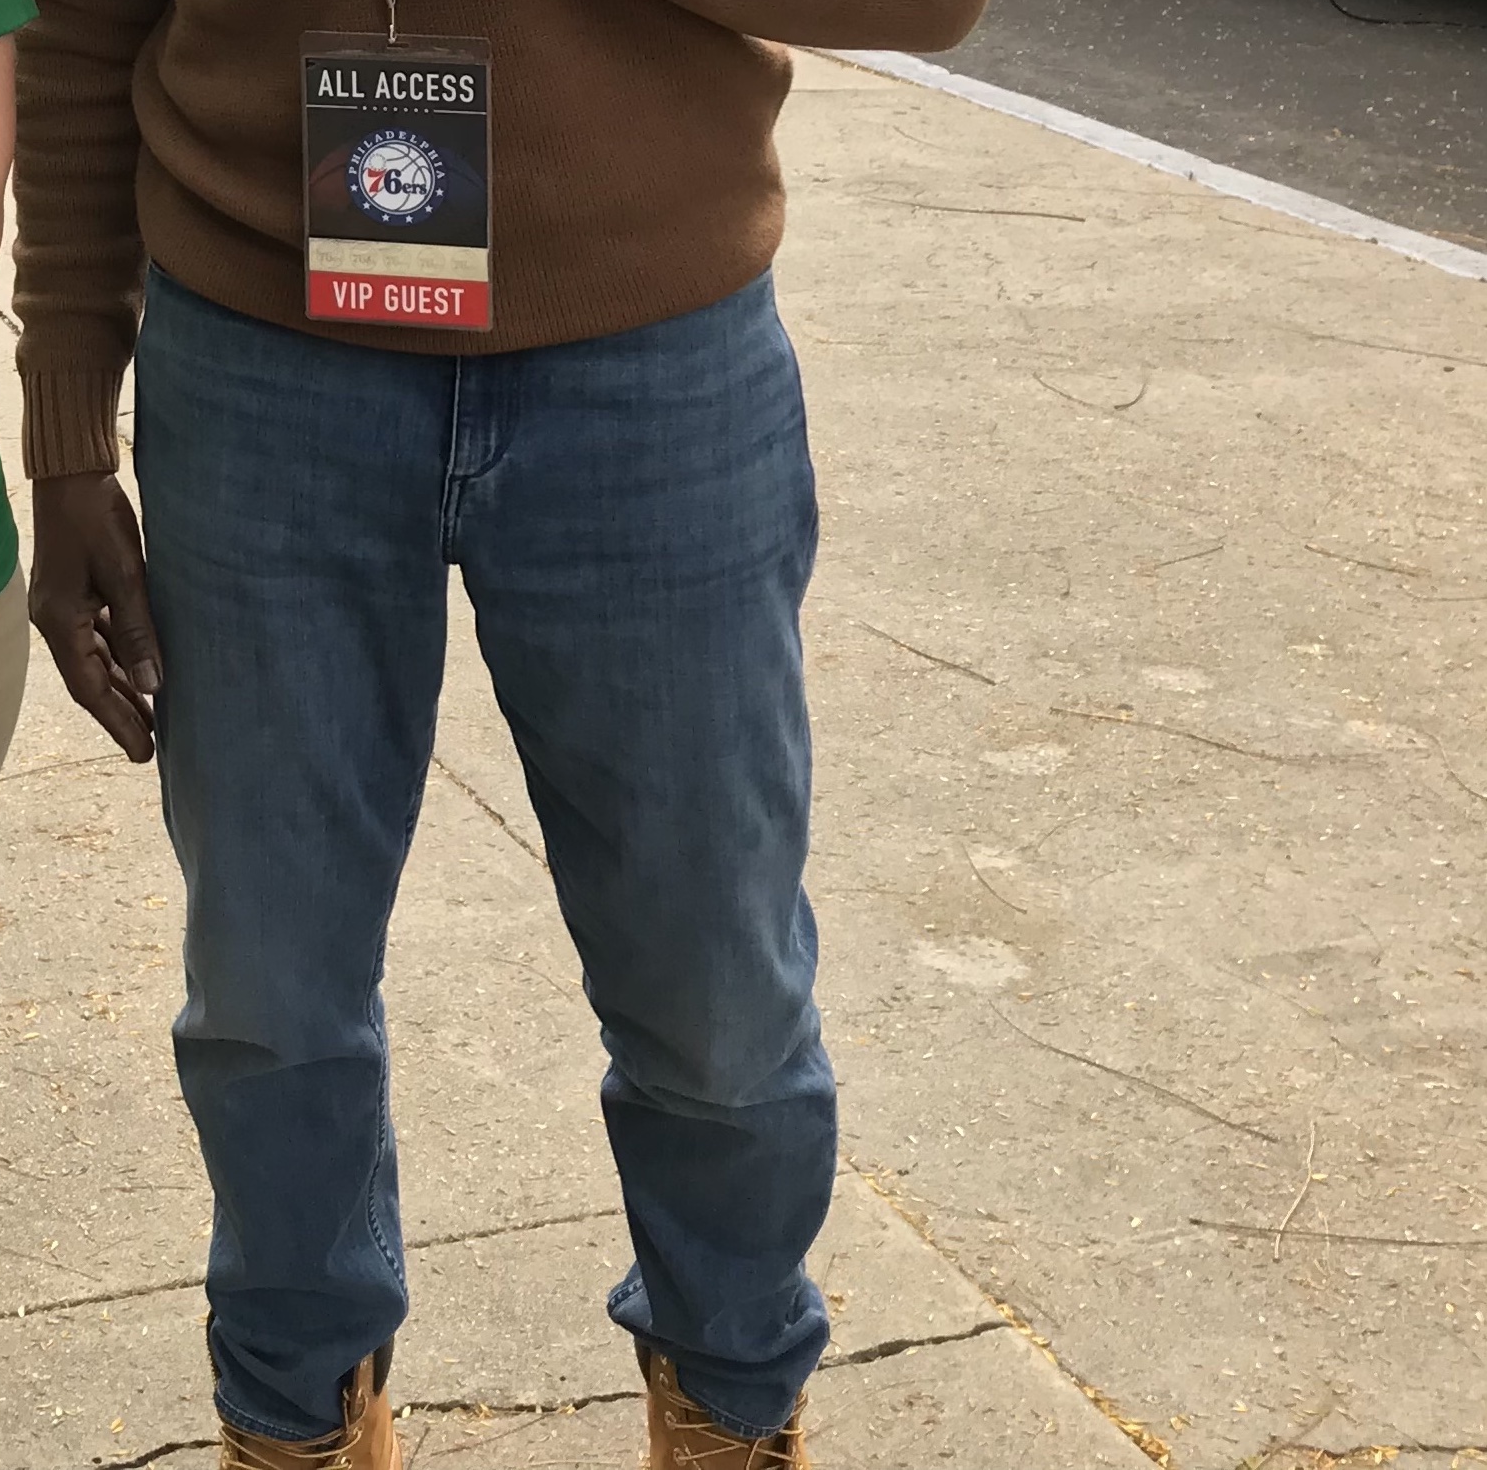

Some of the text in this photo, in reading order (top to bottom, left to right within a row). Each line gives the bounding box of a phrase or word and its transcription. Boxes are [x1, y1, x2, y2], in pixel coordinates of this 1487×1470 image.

[318, 69, 474, 103] ALL ACCESS
[348, 130, 446, 180] PHILADELPHIA
[367, 168, 428, 195] 76ers
[333, 280, 465, 316] VIP GUEST
